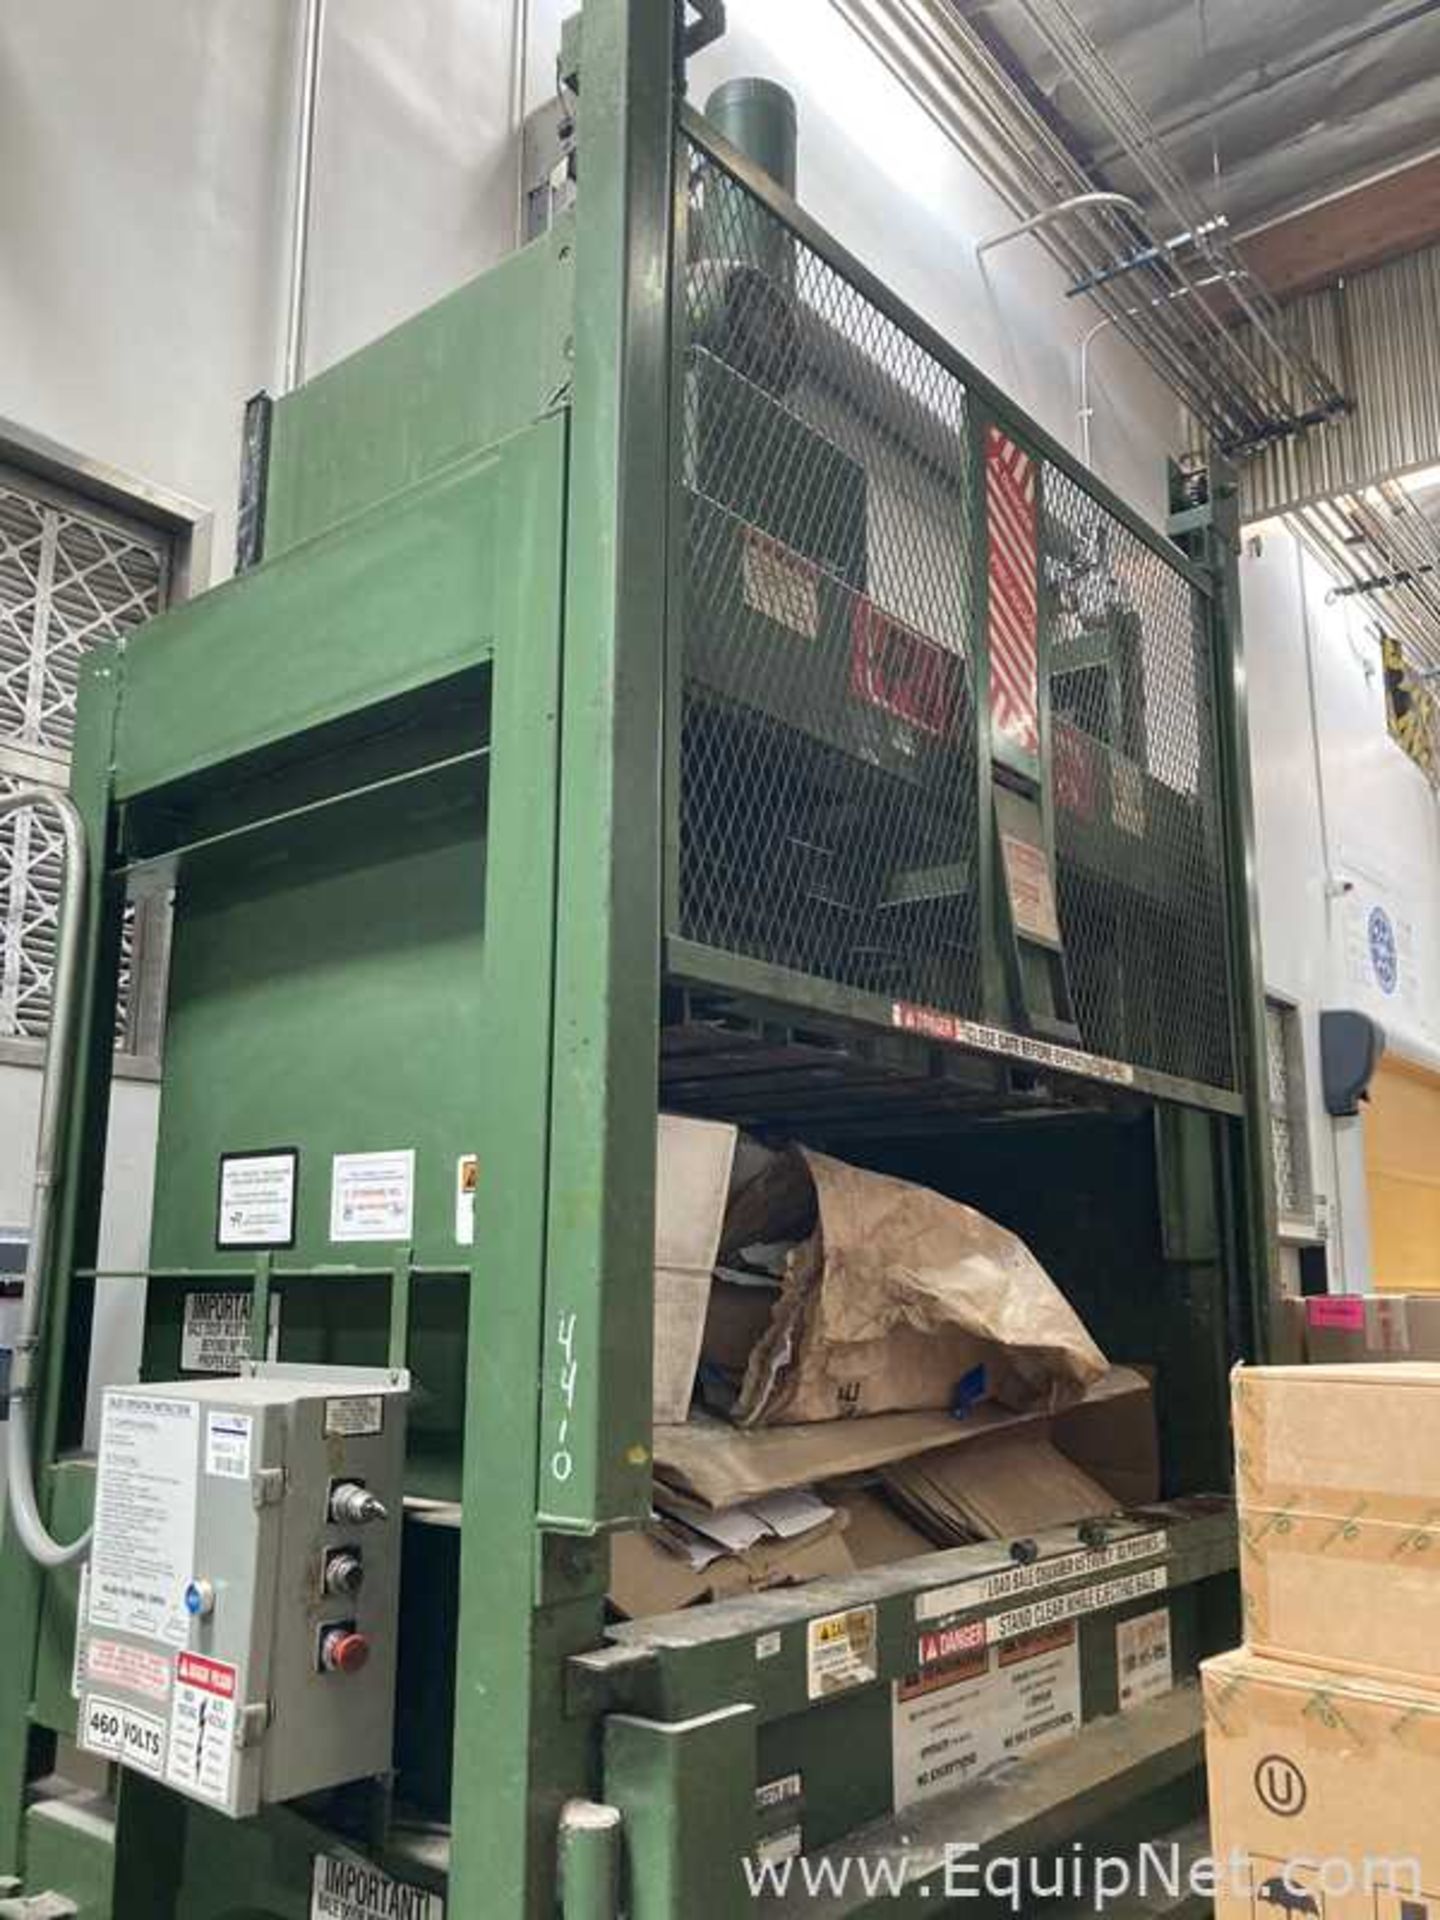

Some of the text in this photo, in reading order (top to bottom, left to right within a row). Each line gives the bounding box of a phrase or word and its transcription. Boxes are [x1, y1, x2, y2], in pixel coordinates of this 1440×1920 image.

[191, 1293, 252, 1320] IMPORTA
[940, 1621, 984, 1651] DANGER
[1000, 1604, 1032, 1635] STAND
[1035, 1597, 1065, 1625] CLEAR
[1067, 1588, 1094, 1613] WHILE
[90, 1711, 161, 1756] 460 VOLTS
